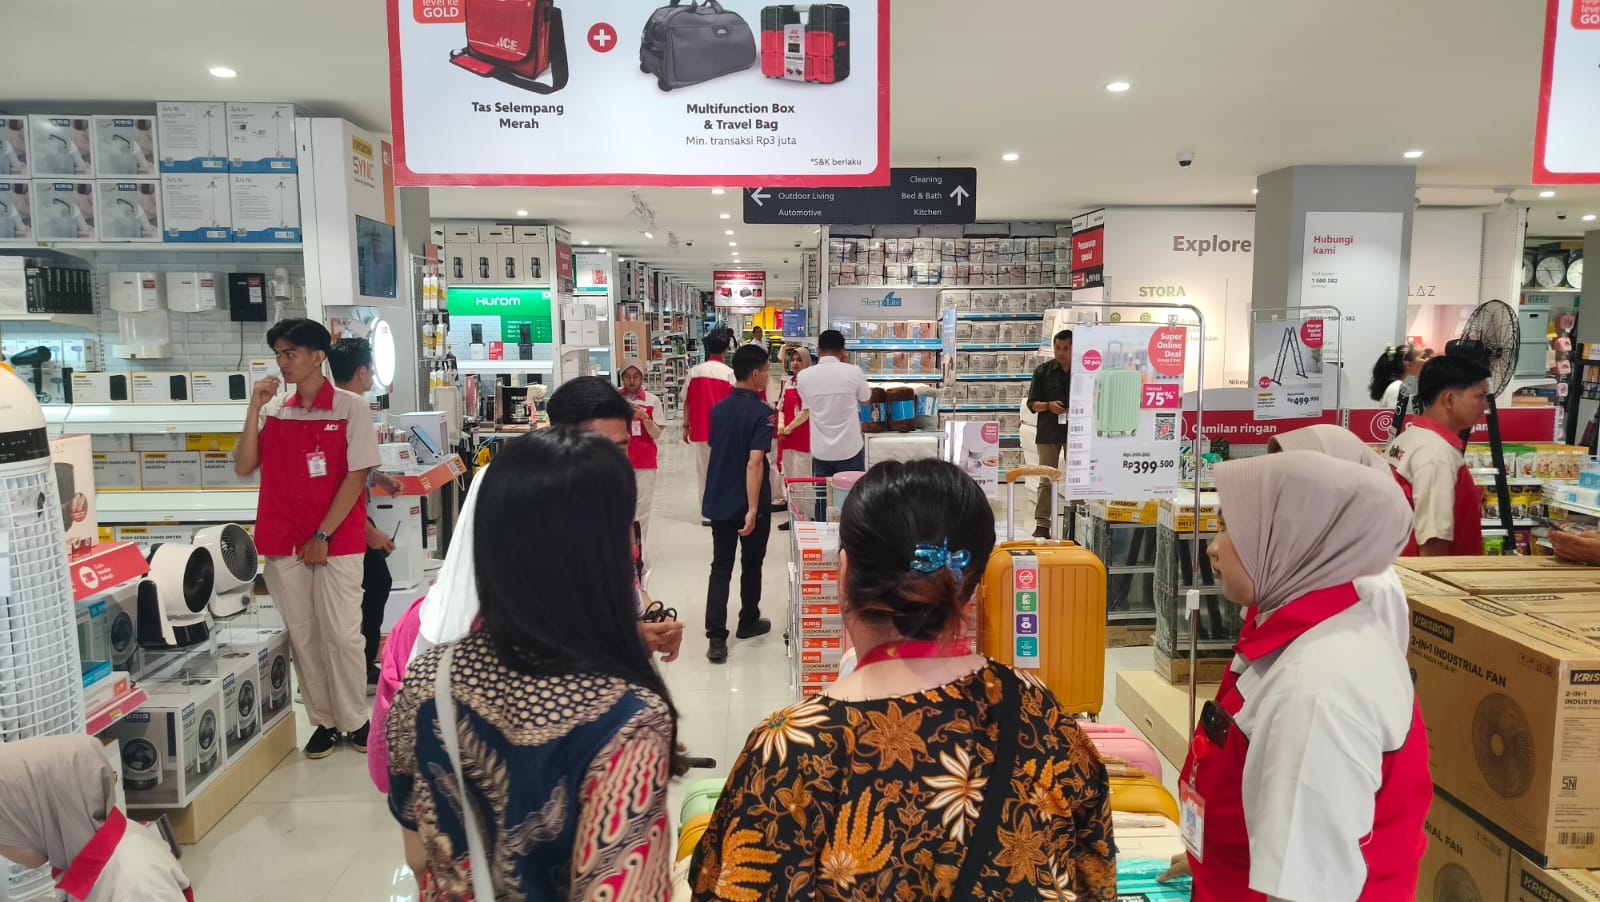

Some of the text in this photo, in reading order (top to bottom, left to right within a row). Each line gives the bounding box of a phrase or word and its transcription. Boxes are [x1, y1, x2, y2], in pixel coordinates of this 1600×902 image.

[423, 7, 459, 18] GOLD
[495, 38, 518, 51] ACE
[472, 102, 564, 116] Tas Selempang
[686, 103, 795, 114] Multifunction Box
[499, 118, 539, 129] Merah
[704, 119, 778, 132] & Travel Bag
[686, 136, 797, 147] Min. transaksi Rp3 juta
[832, 158, 862, 166] berlaku
[352, 155, 375, 181] SYNC
[909, 175, 943, 185] Cleaning
[778, 191, 835, 202] Outdoor Living
[901, 191, 943, 200] Bed & Bath
[778, 208, 822, 217] Automotive
[913, 208, 943, 216] Kitchen
[1173, 234, 1252, 257] Explore
[1313, 235, 1354, 246] Hubungi
[1312, 246, 1336, 255] kami
[1138, 286, 1186, 297] STORA
[1160, 333, 1183, 342] Super
[1164, 350, 1182, 358] Deal
[323, 423, 340, 431] ACE
[1239, 424, 1277, 436] ringan
[1414, 615, 1453, 638] KRISBOW
[1411, 635, 1507, 688] 2-IN-1 INDUSTRIAL FAN
[1445, 837, 1464, 856] FAN
